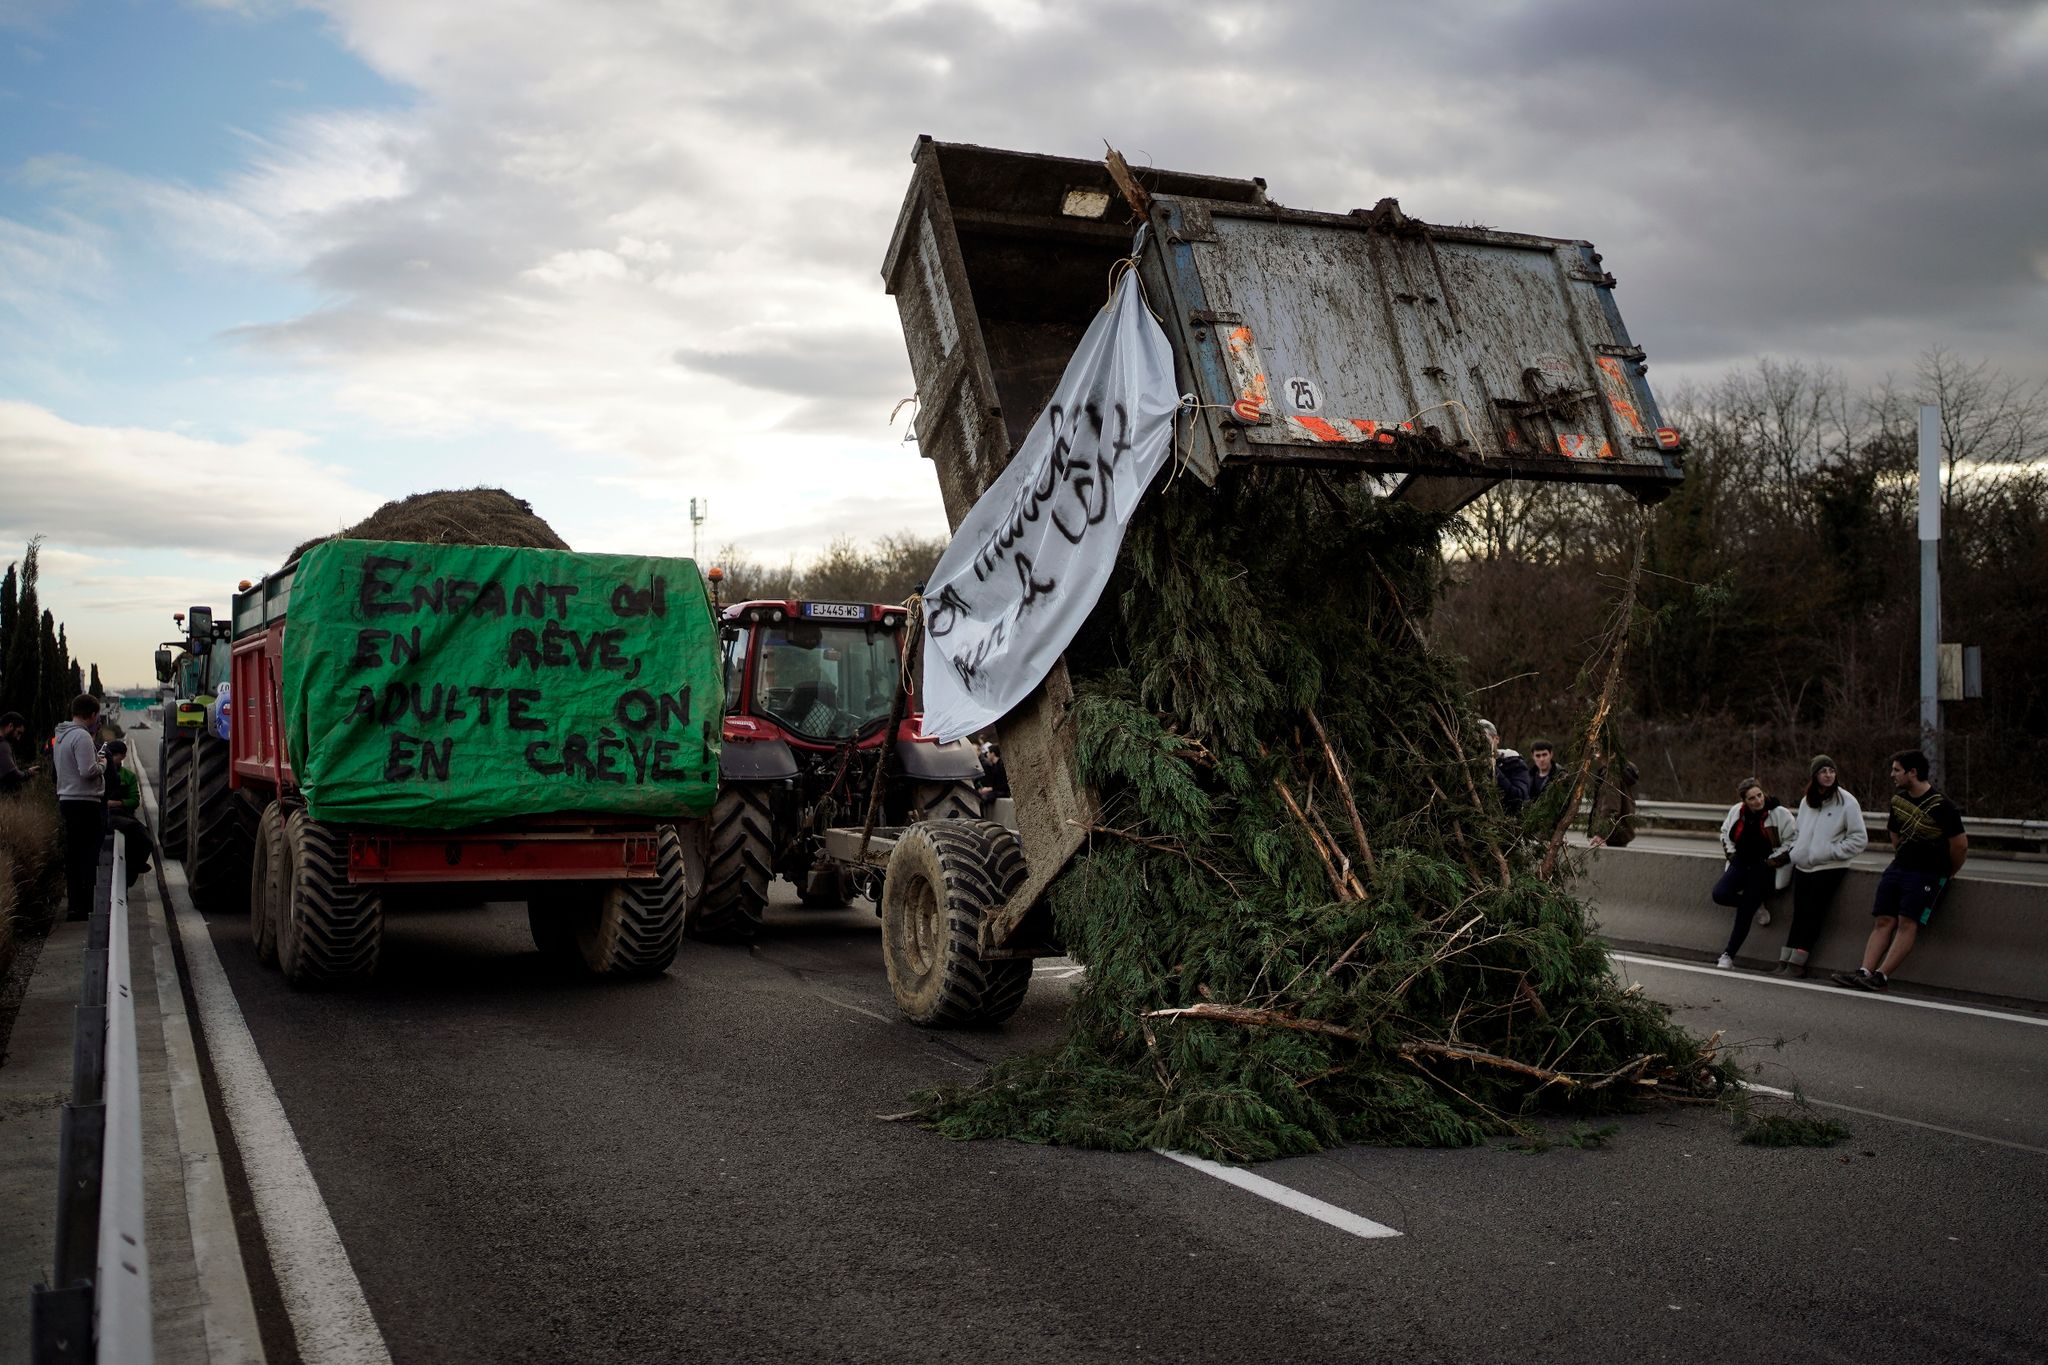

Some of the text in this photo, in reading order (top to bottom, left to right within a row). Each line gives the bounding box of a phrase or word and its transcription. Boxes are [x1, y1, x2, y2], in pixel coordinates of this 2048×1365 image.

[1291, 381, 1315, 409] 25
[361, 557, 578, 619] ENFANT
[355, 626, 420, 668] EN
[344, 682, 691, 731] ADULTE ON
[385, 732, 453, 782] EN
